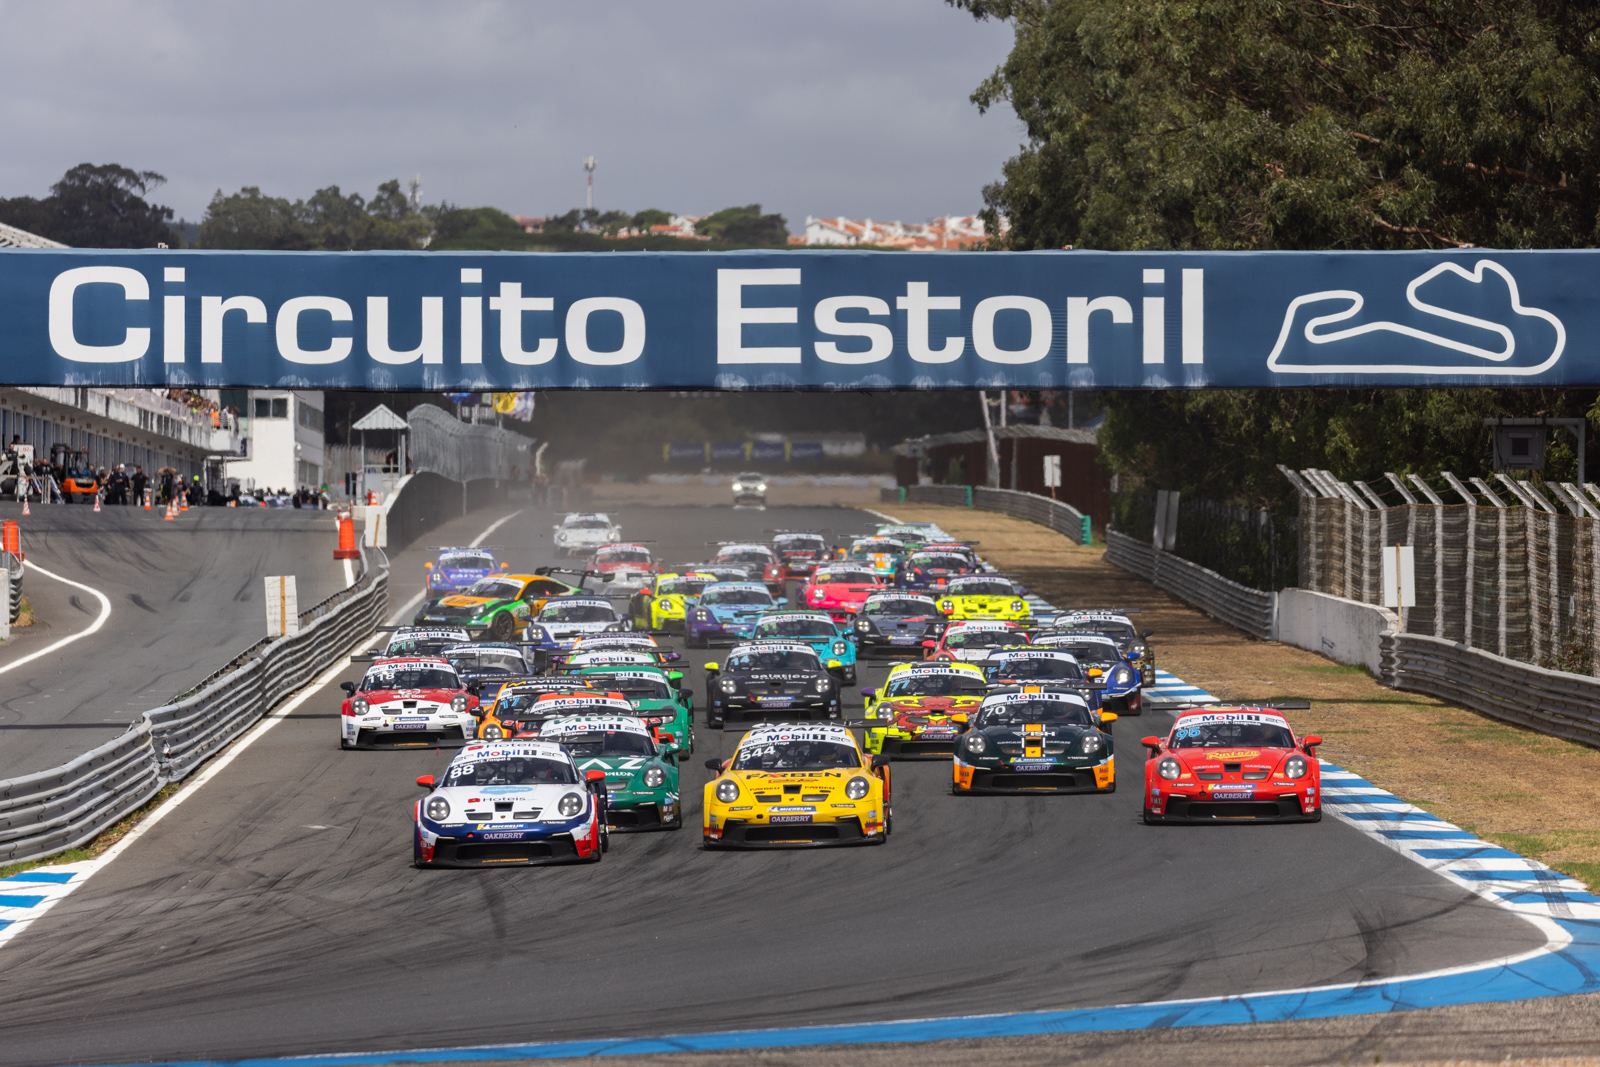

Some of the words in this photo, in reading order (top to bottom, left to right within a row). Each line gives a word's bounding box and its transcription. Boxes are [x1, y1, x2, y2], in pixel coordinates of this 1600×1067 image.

[48, 266, 646, 366] Circuito
[717, 268, 1204, 365] Estoril
[731, 656, 750, 666] 14
[890, 680, 910, 692] 77
[500, 698, 520, 708] 17
[984, 706, 1006, 718] 70
[564, 724, 606, 732] Mobil
[751, 726, 844, 736] PARAFLU
[766, 733, 810, 742] Mobil
[1176, 727, 1201, 740] 95
[476, 750, 520, 758] Mobil
[740, 745, 776, 762] 544
[450, 764, 475, 779] 88
[746, 772, 842, 780] FARBEN
[771, 816, 811, 824] OAKBERRY
[484, 832, 524, 840] OAKBERRY
